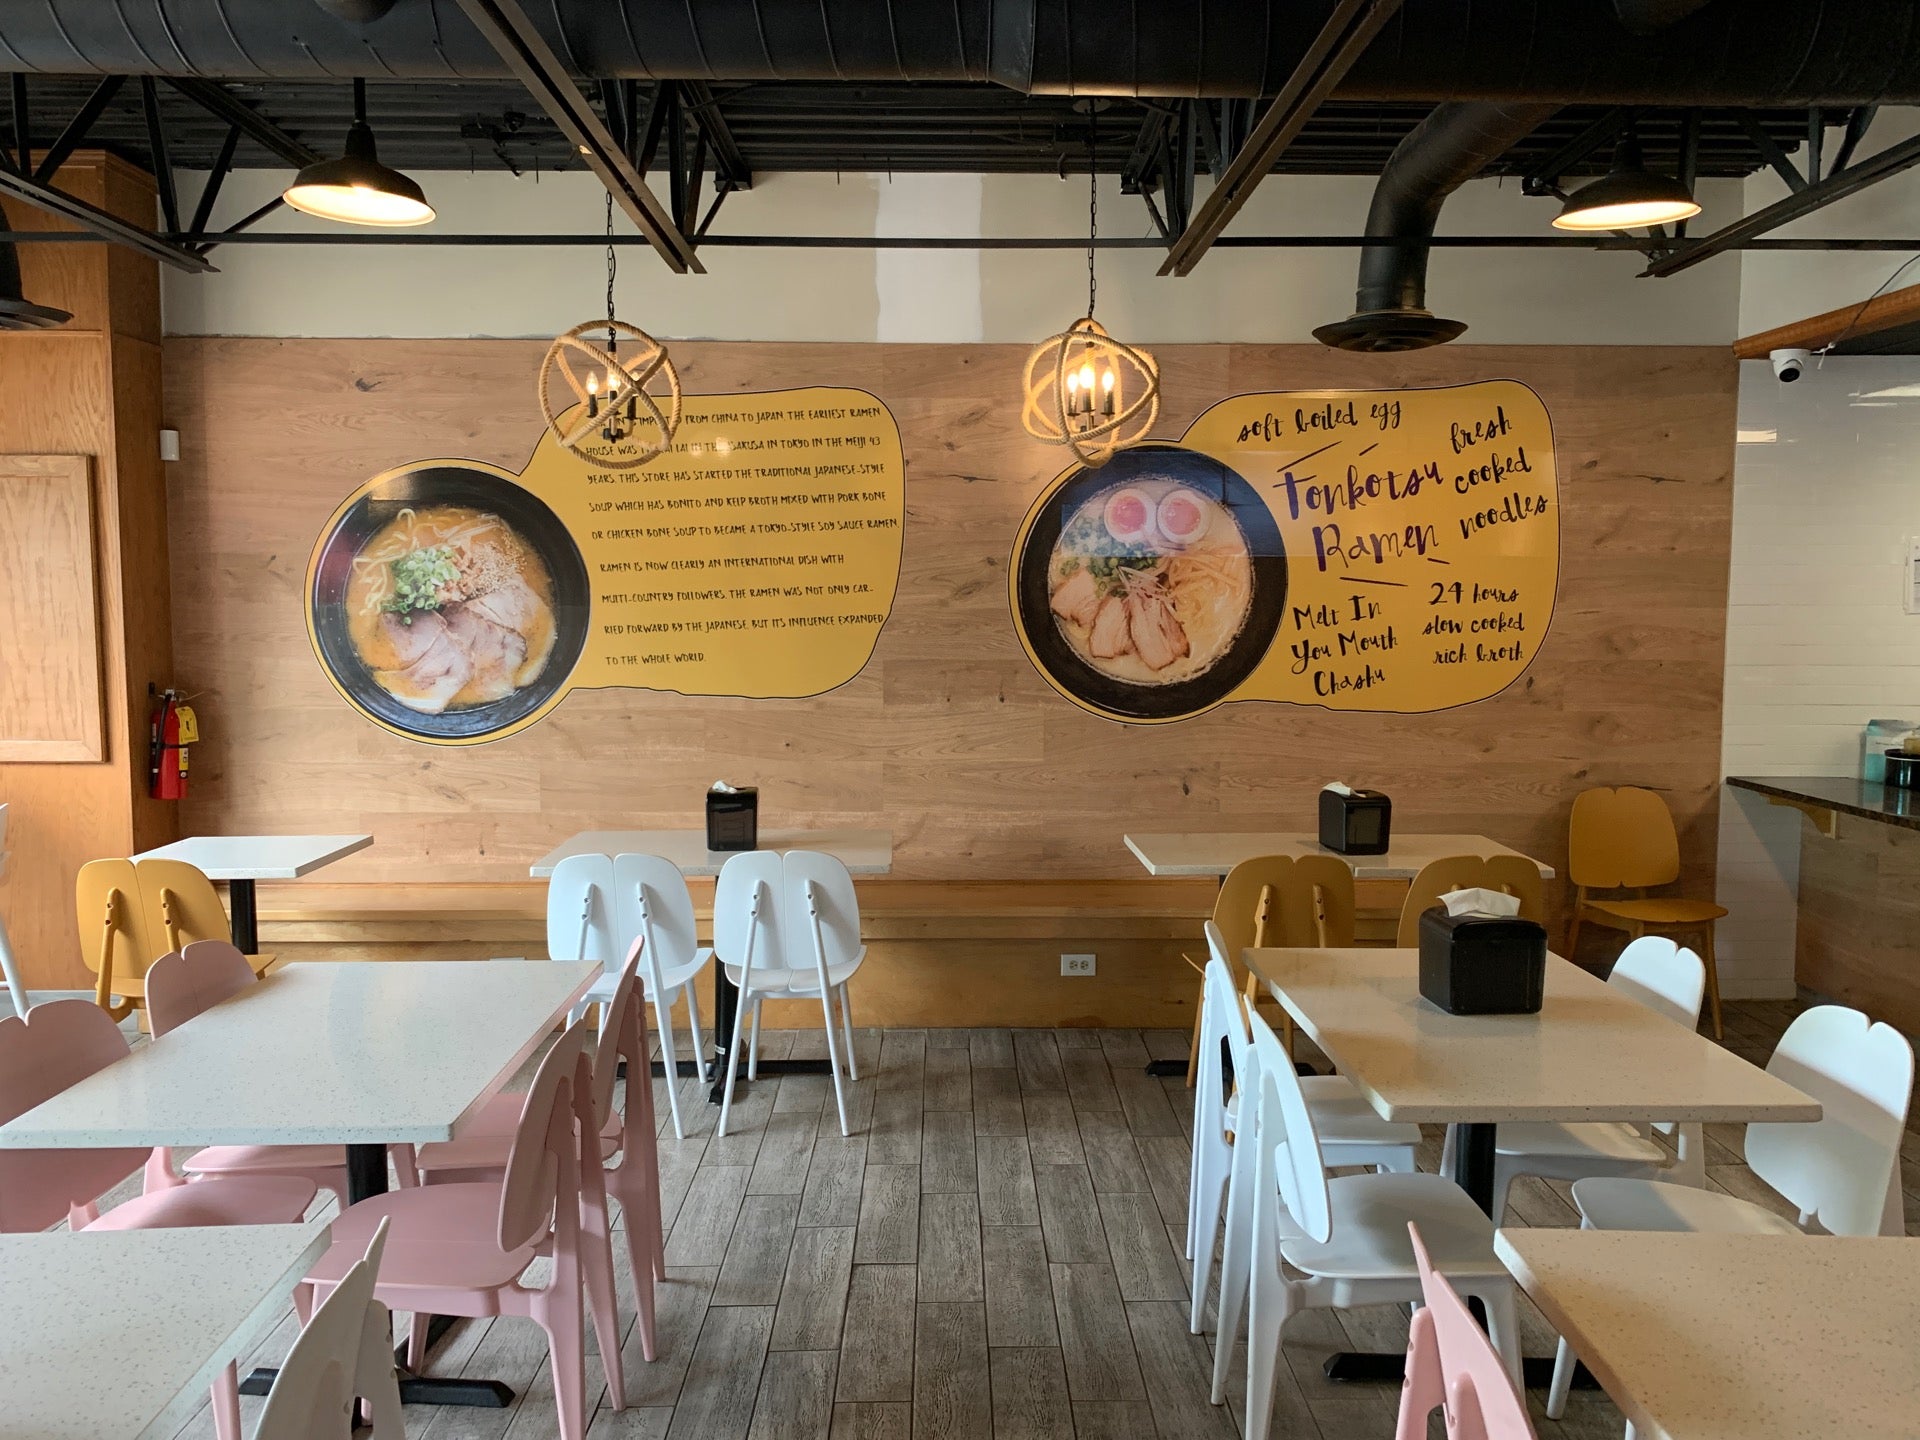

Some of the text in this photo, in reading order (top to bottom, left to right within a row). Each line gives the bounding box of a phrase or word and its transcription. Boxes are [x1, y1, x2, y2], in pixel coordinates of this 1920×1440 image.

[685, 415, 708, 424] FROM
[712, 413, 737, 424] CHINA
[740, 413, 754, 422] TO
[787, 410, 804, 420] THE
[850, 408, 880, 417] RAMEN
[1237, 401, 1401, 443] soft boiled egg
[1449, 405, 1513, 454] fresh
[586, 446, 614, 456] HOUSE
[618, 445, 637, 455] WAS
[767, 440, 777, 449] IN
[780, 439, 809, 448] TOKYO
[812, 438, 823, 447] IN
[825, 437, 842, 447] THE
[618, 473, 639, 483] THIS
[642, 472, 670, 482] STORE
[673, 471, 691, 481] HAS
[693, 470, 732, 480] STARTED
[734, 469, 752, 479] THE
[754, 467, 811, 478] TRADITIONAL
[1454, 446, 1532, 494] cooked
[1272, 460, 1443, 520] Tonkotsu
[589, 492, 886, 512] SOUP WHICH HAS BONITO AND KELP BROTH MIXED WITH PORK BONE
[1459, 492, 1548, 539] noodles
[592, 531, 603, 540] OR
[607, 529, 643, 539] CHICKEN
[646, 528, 670, 537] BONE
[673, 527, 696, 536] SOUP
[698, 527, 711, 536] TO
[714, 525, 746, 535] BECAME
[750, 525, 755, 533] A
[818, 521, 834, 531] SOY
[837, 520, 864, 530] SAUCE
[1312, 523, 1439, 572] Ramen
[600, 554, 844, 572] RAMEN IS NOW CLEARLY AN INTERNATIONAL DISH WITH
[729, 589, 746, 599] THE
[750, 588, 780, 597] RAMEN
[783, 586, 802, 597] WAS
[805, 586, 823, 595] NOT
[828, 585, 849, 594] ONLY
[1428, 582, 1519, 605] 24 hours
[604, 625, 623, 635] RIED
[627, 624, 669, 634] FORWARD
[672, 623, 683, 632] BY
[685, 622, 702, 631] THE
[752, 619, 768, 629] BUT
[772, 618, 786, 628] ITS
[789, 616, 835, 627] INFLUENCE
[838, 614, 884, 624] EXPANDED
[1293, 595, 1381, 631] Melt In
[1422, 612, 1525, 635] slow cooked
[605, 656, 619, 665] TO
[621, 655, 638, 664] THE
[641, 654, 670, 664] WHOLE
[1291, 625, 1398, 675] You Mouth
[1433, 641, 1523, 664] rich broth
[1314, 665, 1385, 696] Chashu
